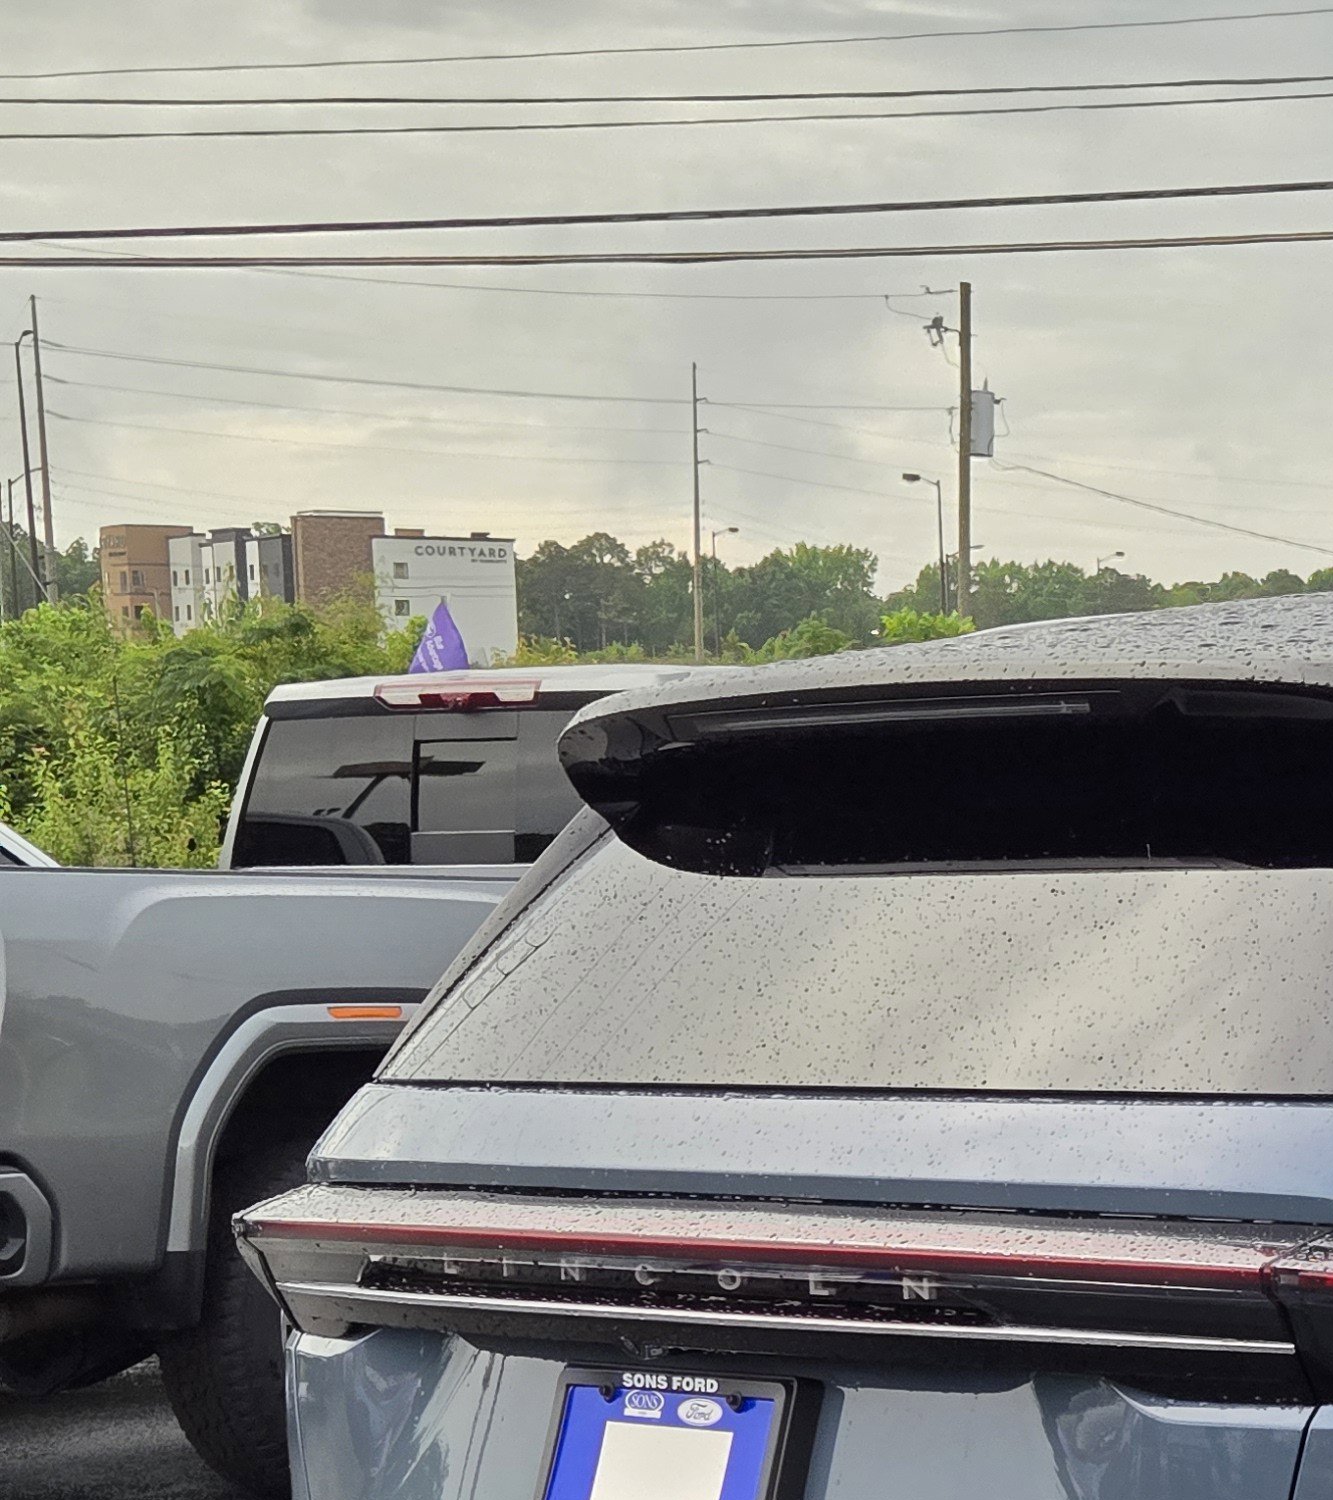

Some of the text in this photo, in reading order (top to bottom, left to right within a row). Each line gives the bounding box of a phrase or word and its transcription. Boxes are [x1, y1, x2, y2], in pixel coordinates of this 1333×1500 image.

[414, 545, 507, 559] COURTYARD
[443, 1256, 930, 1301] LINCOLN
[622, 1373, 719, 1393] SONS FORD
[630, 1393, 660, 1410] SONS
[685, 1402, 714, 1421] Ford
